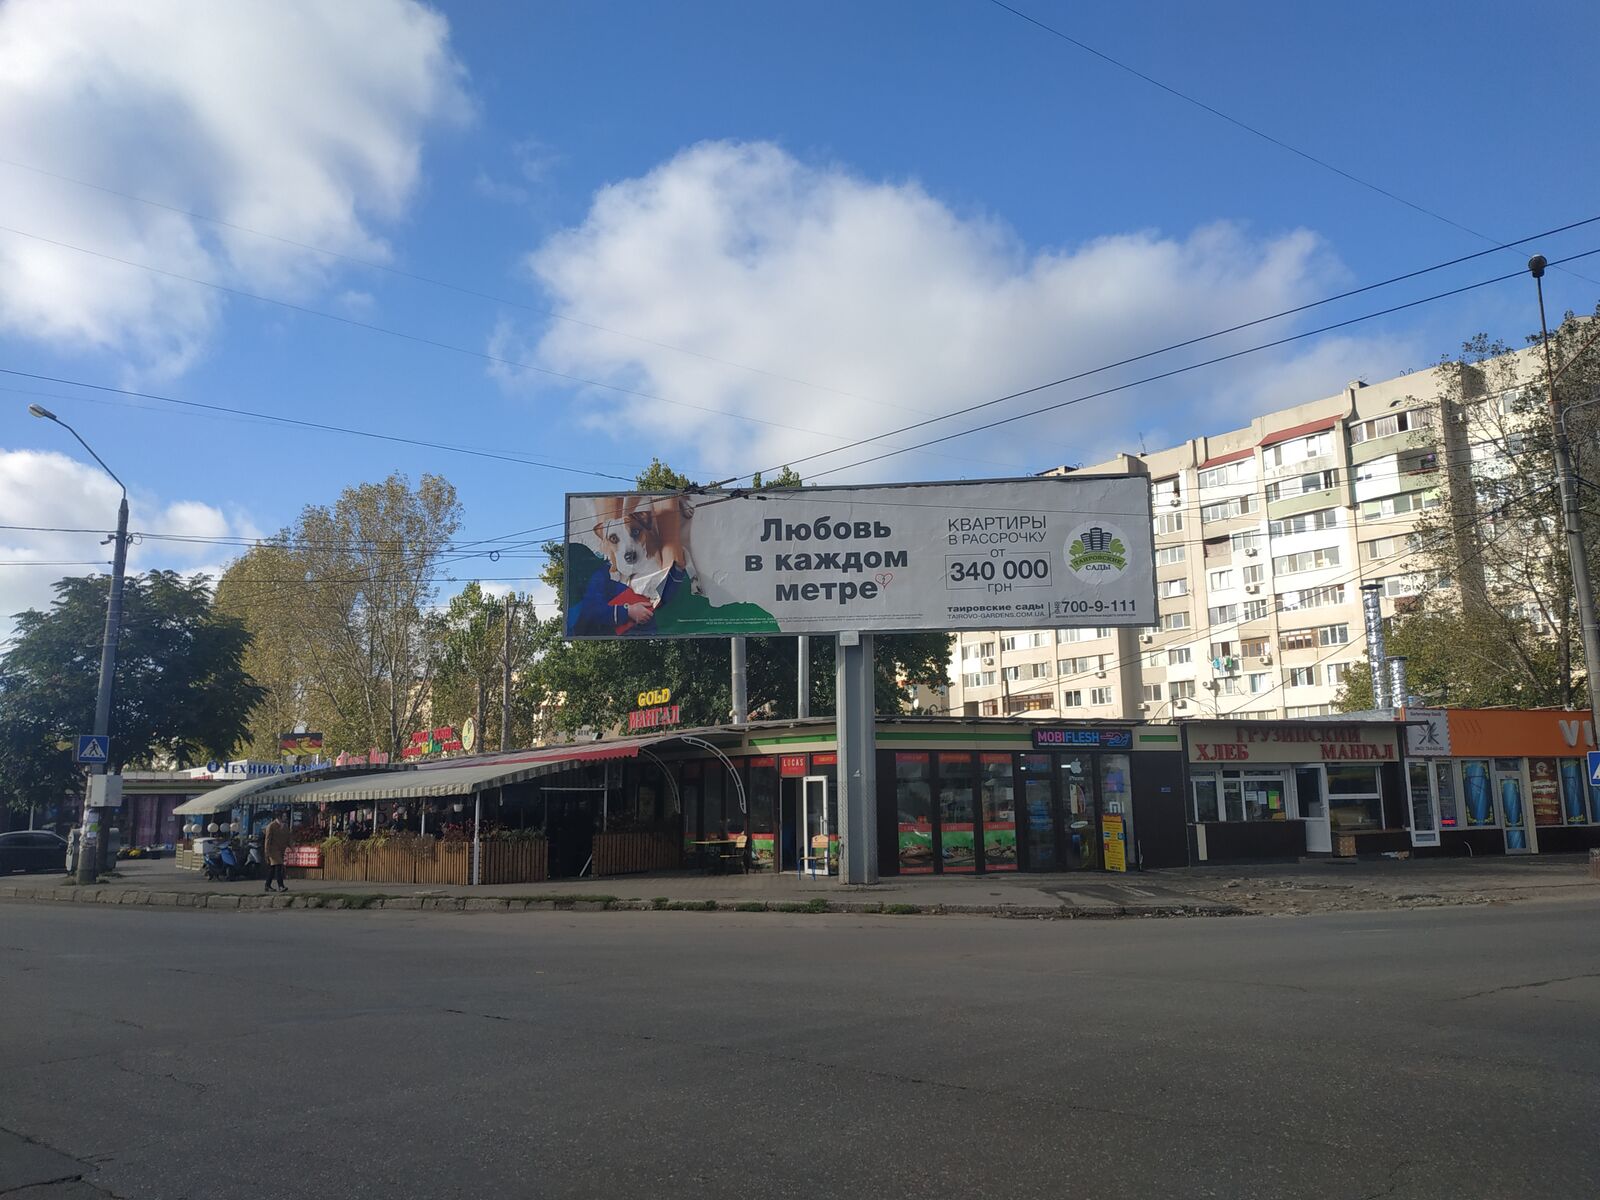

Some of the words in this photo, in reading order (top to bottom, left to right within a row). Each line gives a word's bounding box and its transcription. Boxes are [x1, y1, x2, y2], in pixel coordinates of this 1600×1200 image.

[760, 515, 892, 542] Любовь
[948, 515, 1046, 532] КВАРТИРЫ
[948, 534, 958, 545] В
[962, 531, 1047, 545] РАССРОЧКУ
[745, 555, 763, 571] в
[775, 550, 908, 573] каждом
[1075, 554, 1123, 566] ТАИРОВСКИЕ
[950, 560, 995, 582] 340
[1003, 558, 1049, 580] 000
[775, 580, 878, 605] метре
[987, 582, 1012, 595] грн
[947, 603, 1012, 614] таировские
[1015, 602, 1044, 611] сады
[1061, 599, 1136, 613] 700-9-111
[637, 687, 671, 707] GOLD
[628, 704, 680, 729] МАНГАЛ
[1037, 731, 1100, 743] MOBIFLESH
[1195, 743, 1249, 761] ХЛЕБ
[1320, 743, 1394, 760] МАНГАЛ
[783, 758, 804, 767] LUCAS
